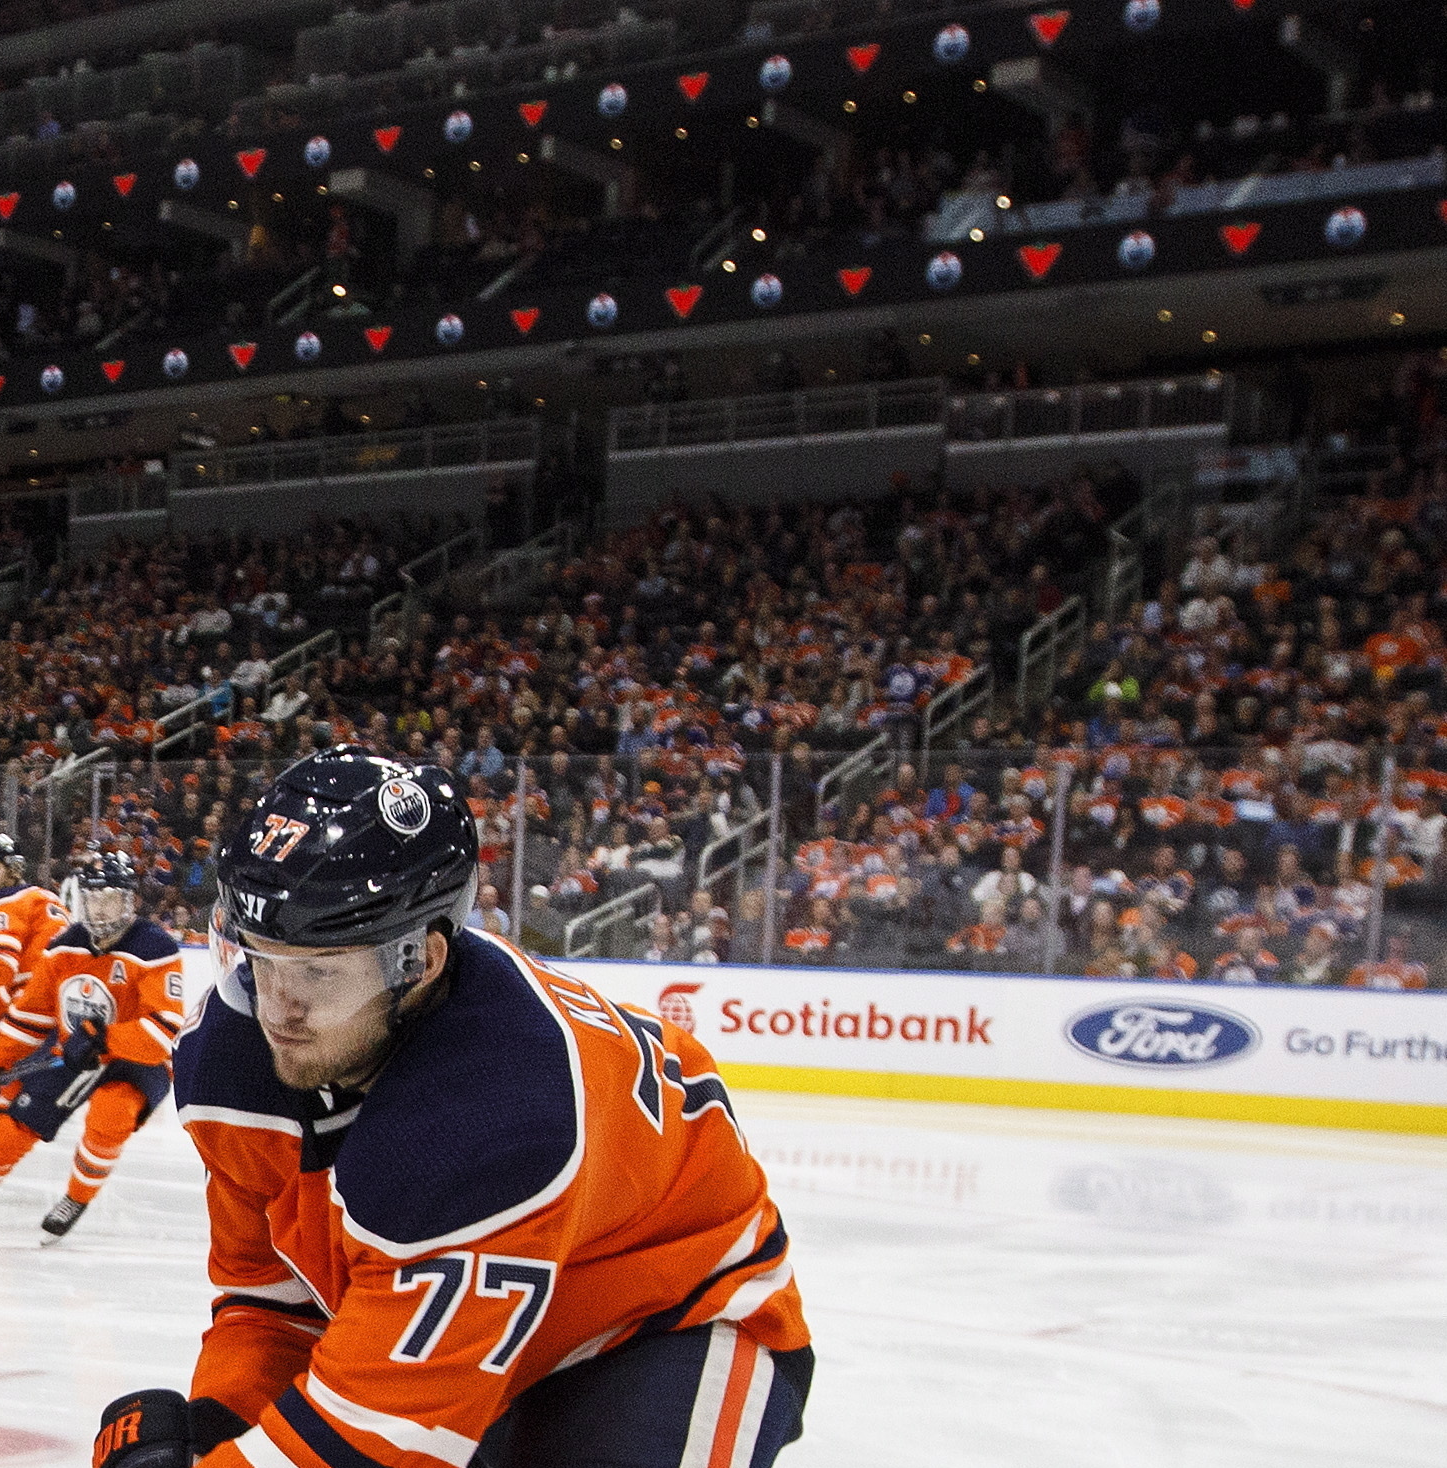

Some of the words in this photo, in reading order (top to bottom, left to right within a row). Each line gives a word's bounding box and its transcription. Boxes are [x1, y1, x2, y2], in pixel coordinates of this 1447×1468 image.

[255, 813, 310, 862] 77
[109, 959, 127, 985] A
[720, 998, 993, 1045] Scotiabank
[1097, 1005, 1223, 1061] Ford
[1286, 1027, 1335, 1056] Go
[388, 1250, 559, 1376] 77
